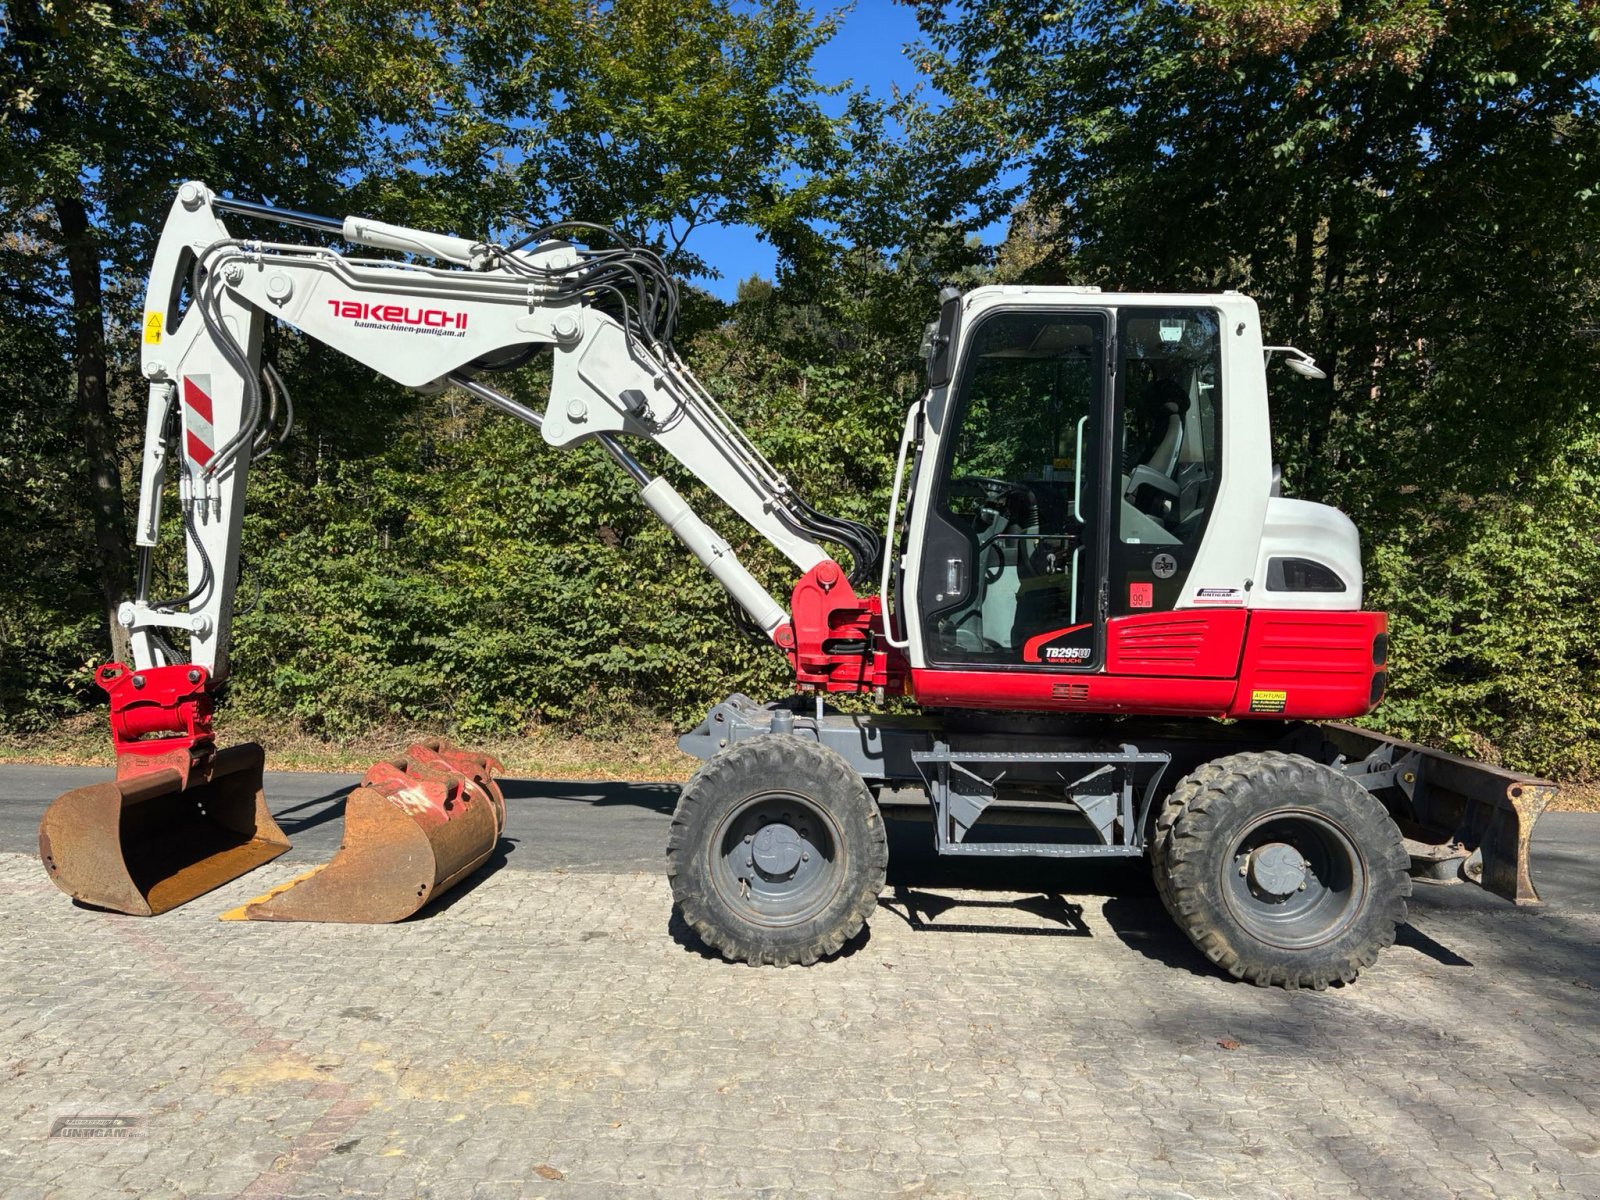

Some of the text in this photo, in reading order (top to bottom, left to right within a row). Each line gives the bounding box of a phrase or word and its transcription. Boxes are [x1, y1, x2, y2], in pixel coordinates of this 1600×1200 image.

[328, 300, 468, 329] TAKEUCHI
[354, 320, 466, 338] baumaschinen-puntigam.at
[1046, 647, 1091, 658] TB295W
